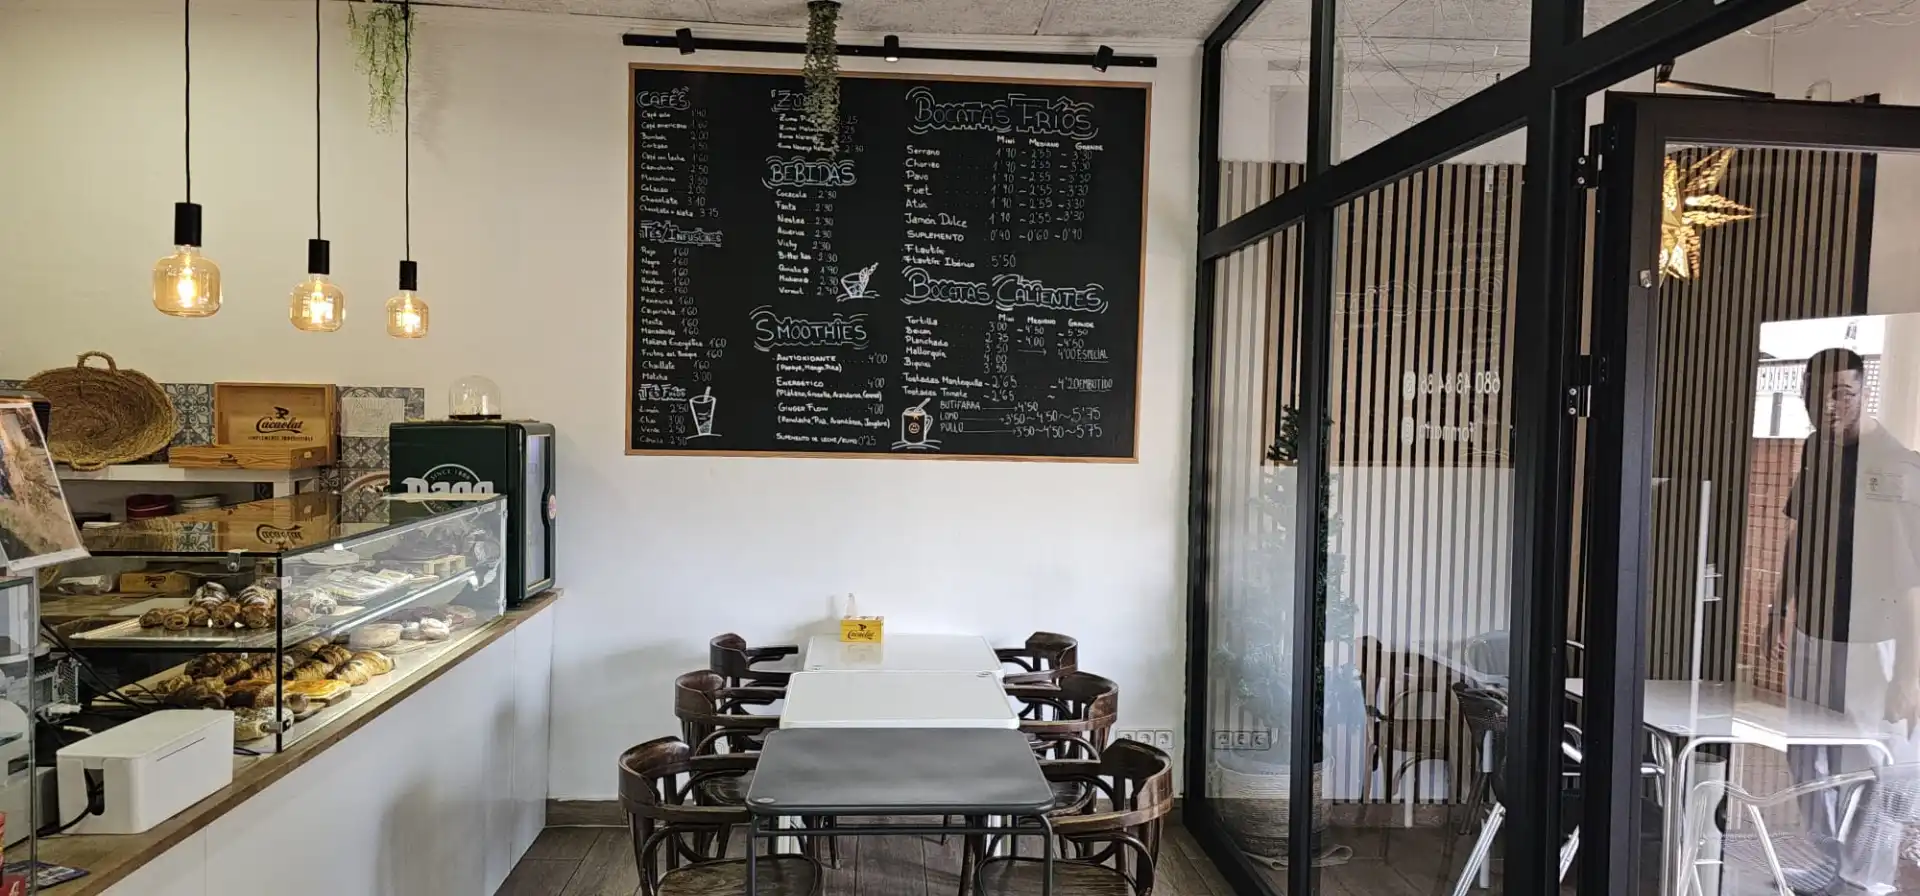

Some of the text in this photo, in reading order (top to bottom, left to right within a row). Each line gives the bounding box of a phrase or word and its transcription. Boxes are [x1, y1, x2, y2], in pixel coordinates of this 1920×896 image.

[915, 97, 1010, 125] BOCATAS
[906, 145, 940, 156] Serrano
[905, 158, 940, 168] Chorizo
[771, 163, 855, 183] BEBIDAS
[906, 170, 928, 181] Pavo
[904, 184, 932, 195] Fuet
[938, 213, 968, 228] Dulce
[907, 230, 964, 242] SUPLEMENTO
[992, 254, 1016, 267] 5'50
[906, 273, 1101, 307] BOCATAS CALIENTES
[906, 316, 938, 326] Tortilla
[905, 335, 948, 347] Planchado
[992, 376, 1018, 388] 2'65
[992, 389, 1015, 401] 2'65
[1017, 402, 1039, 412] 4'50
[1071, 406, 1101, 422] 5'75
[256, 416, 304, 433] Cacaolat
[1077, 423, 1102, 437] 5'75
